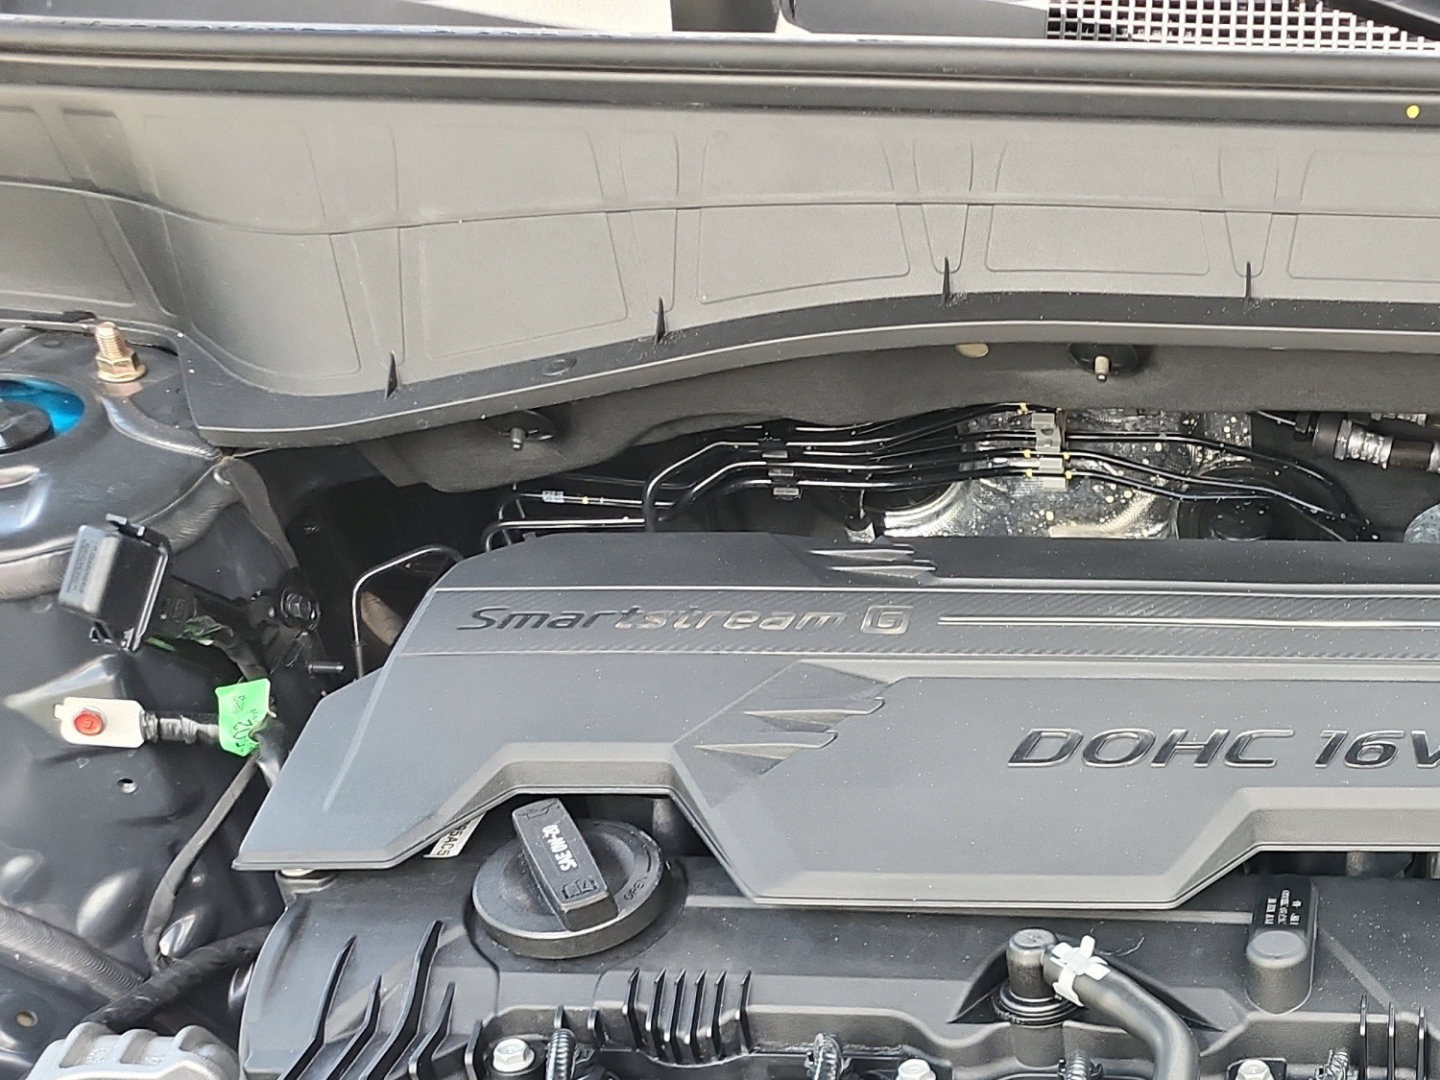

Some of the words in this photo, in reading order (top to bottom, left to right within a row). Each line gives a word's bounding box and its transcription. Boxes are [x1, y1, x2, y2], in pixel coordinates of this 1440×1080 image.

[456, 605, 846, 632] Smartstream
[1007, 727, 1295, 770] DOHC
[554, 850, 578, 871] SAE
